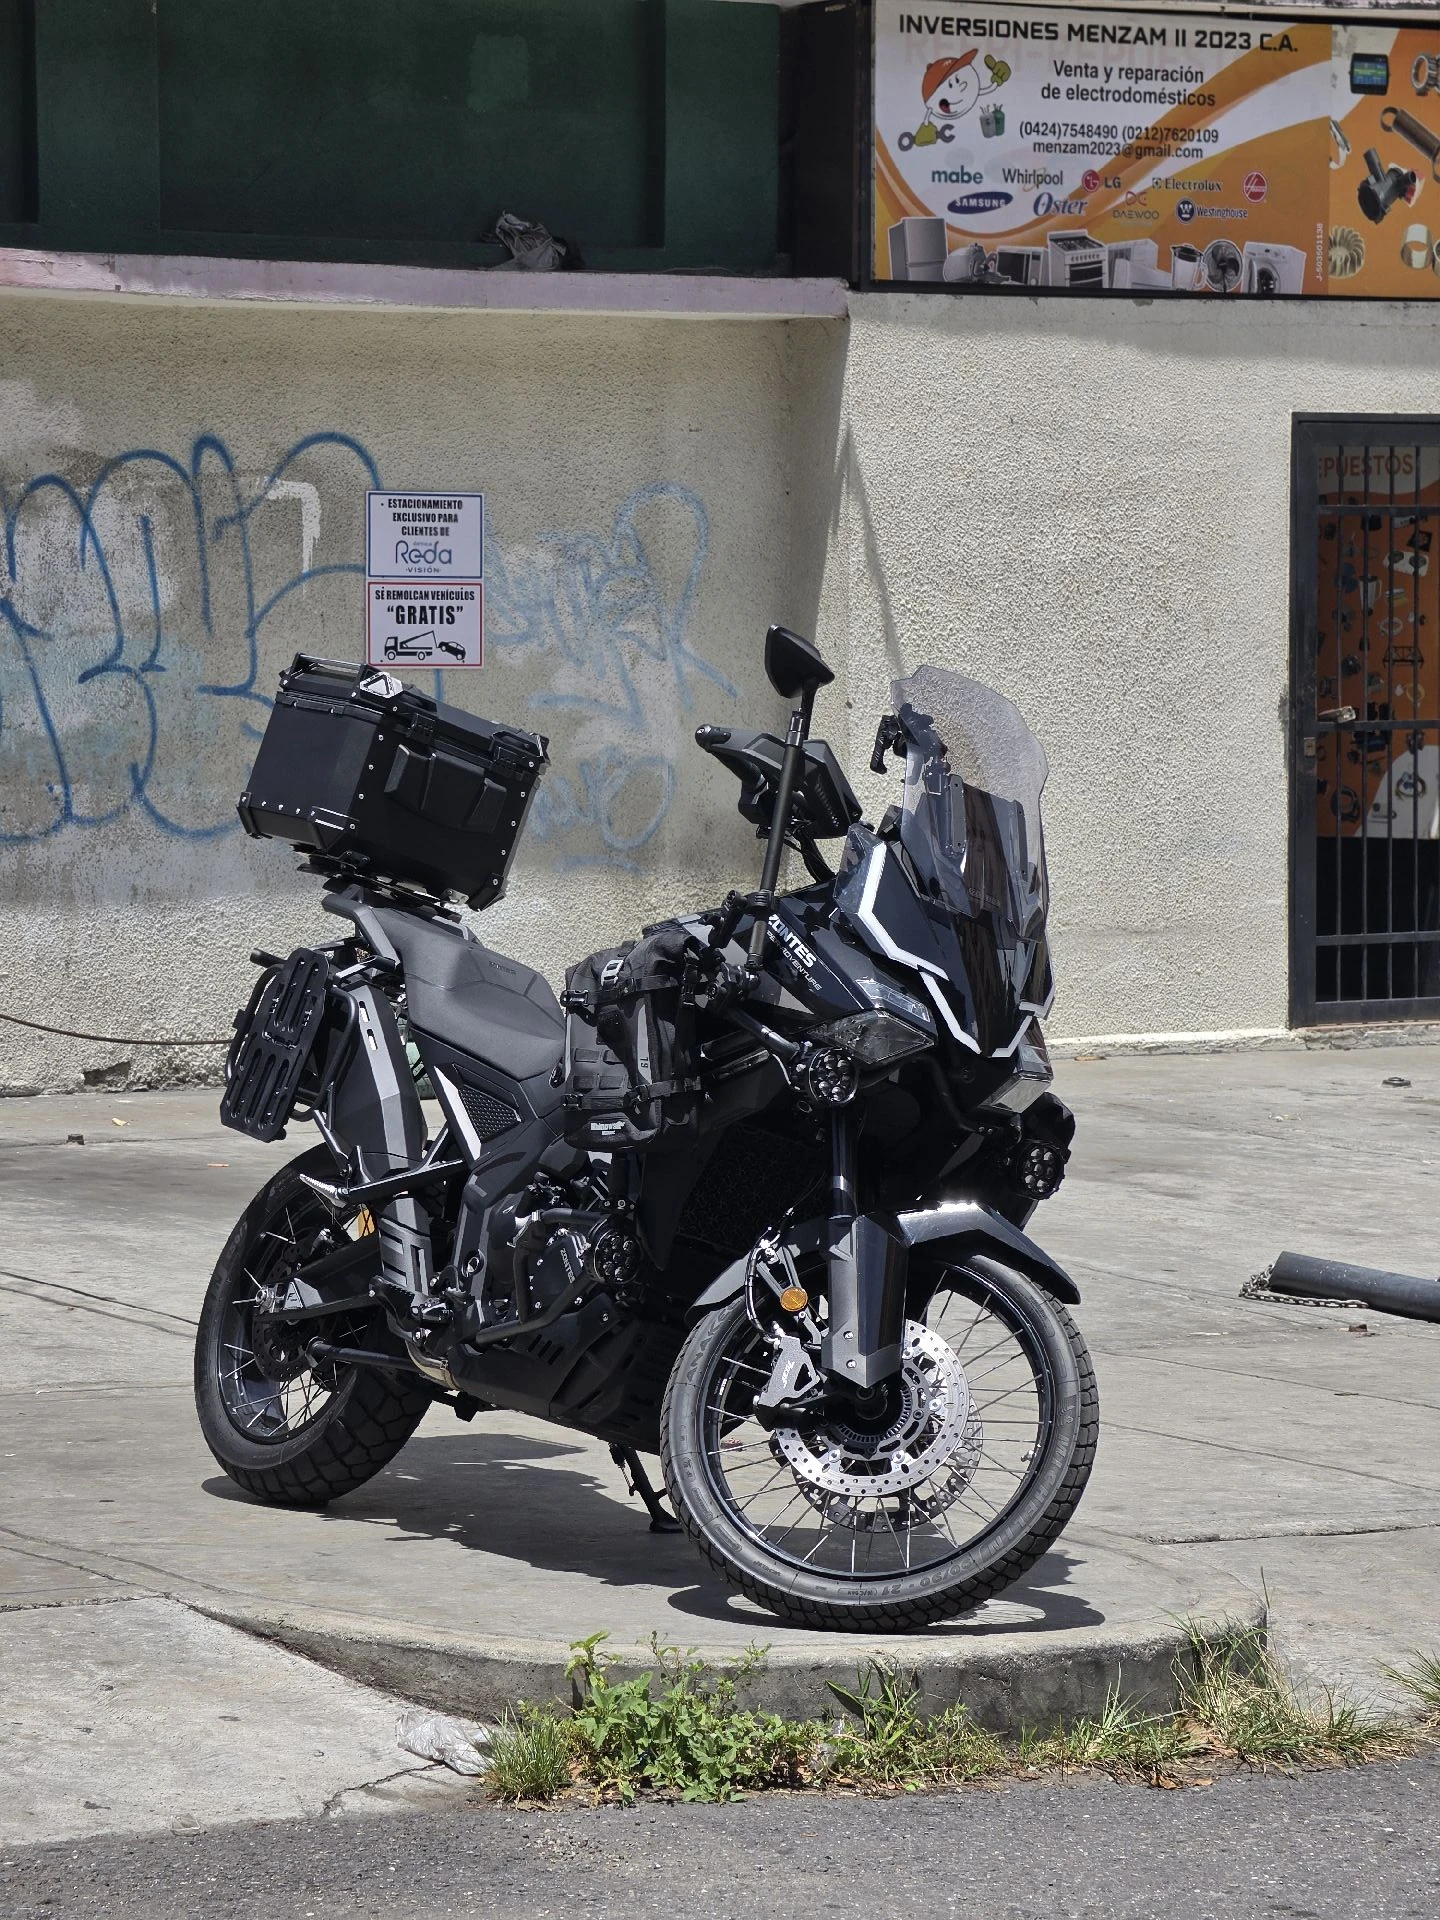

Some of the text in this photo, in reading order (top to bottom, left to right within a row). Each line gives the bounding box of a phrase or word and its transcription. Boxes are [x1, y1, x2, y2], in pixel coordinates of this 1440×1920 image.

[899, 14, 1299, 53] INVERSIONES MENZAM II 2023 C.A.
[1053, 60, 1204, 84] Venta y reparación
[1041, 83, 1216, 106] de electrodomésticos
[1019, 121, 1219, 144] (0424)7548490 (0212)7620109
[1033, 141, 1203, 160] menzam2023@gmail.com
[931, 165, 1222, 192] mabe Whirlpool LG Electrolux
[955, 197, 1006, 208] SAMSUNG
[1033, 191, 1088, 217] Oster
[1112, 209, 1159, 220] DAEWOO
[1196, 206, 1248, 219] Westinghouse
[388, 498, 463, 510] ESTACIONAMIENTO
[392, 512, 459, 523] EXCLUSIVO PARA
[401, 526, 450, 537] CLIENTES DE
[395, 540, 452, 565] Reda
[386, 590, 430, 601] REMOLCAN
[430, 588, 475, 601] VEHÍCULOS
